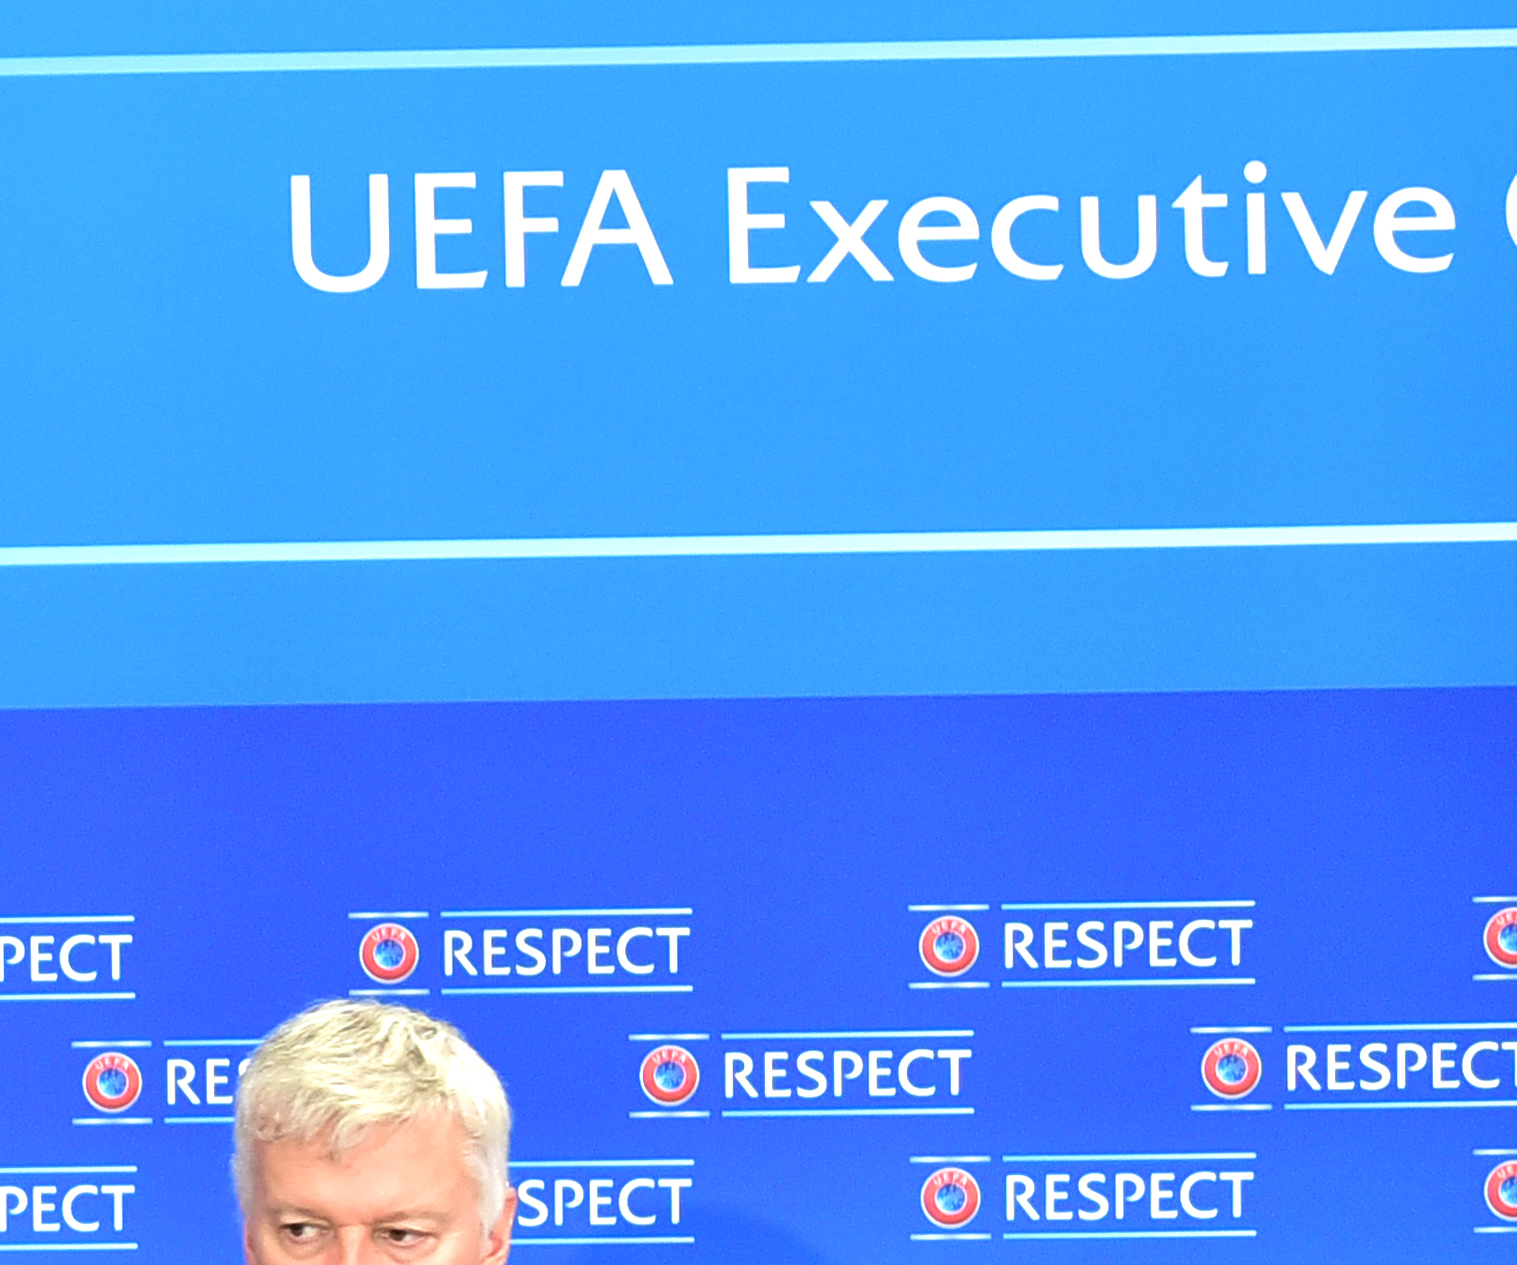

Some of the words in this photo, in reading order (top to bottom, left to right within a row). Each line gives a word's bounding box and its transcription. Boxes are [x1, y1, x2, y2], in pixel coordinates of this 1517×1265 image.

[290, 169, 674, 293] UEFA
[727, 160, 1456, 284] Executive
[445, 927, 690, 976] RESPECT
[1005, 920, 1253, 968] RESPECT
[724, 1049, 972, 1098] RESPECT
[517, 1178, 692, 1226] SPECT
[1007, 1172, 1254, 1220] RESPECT
